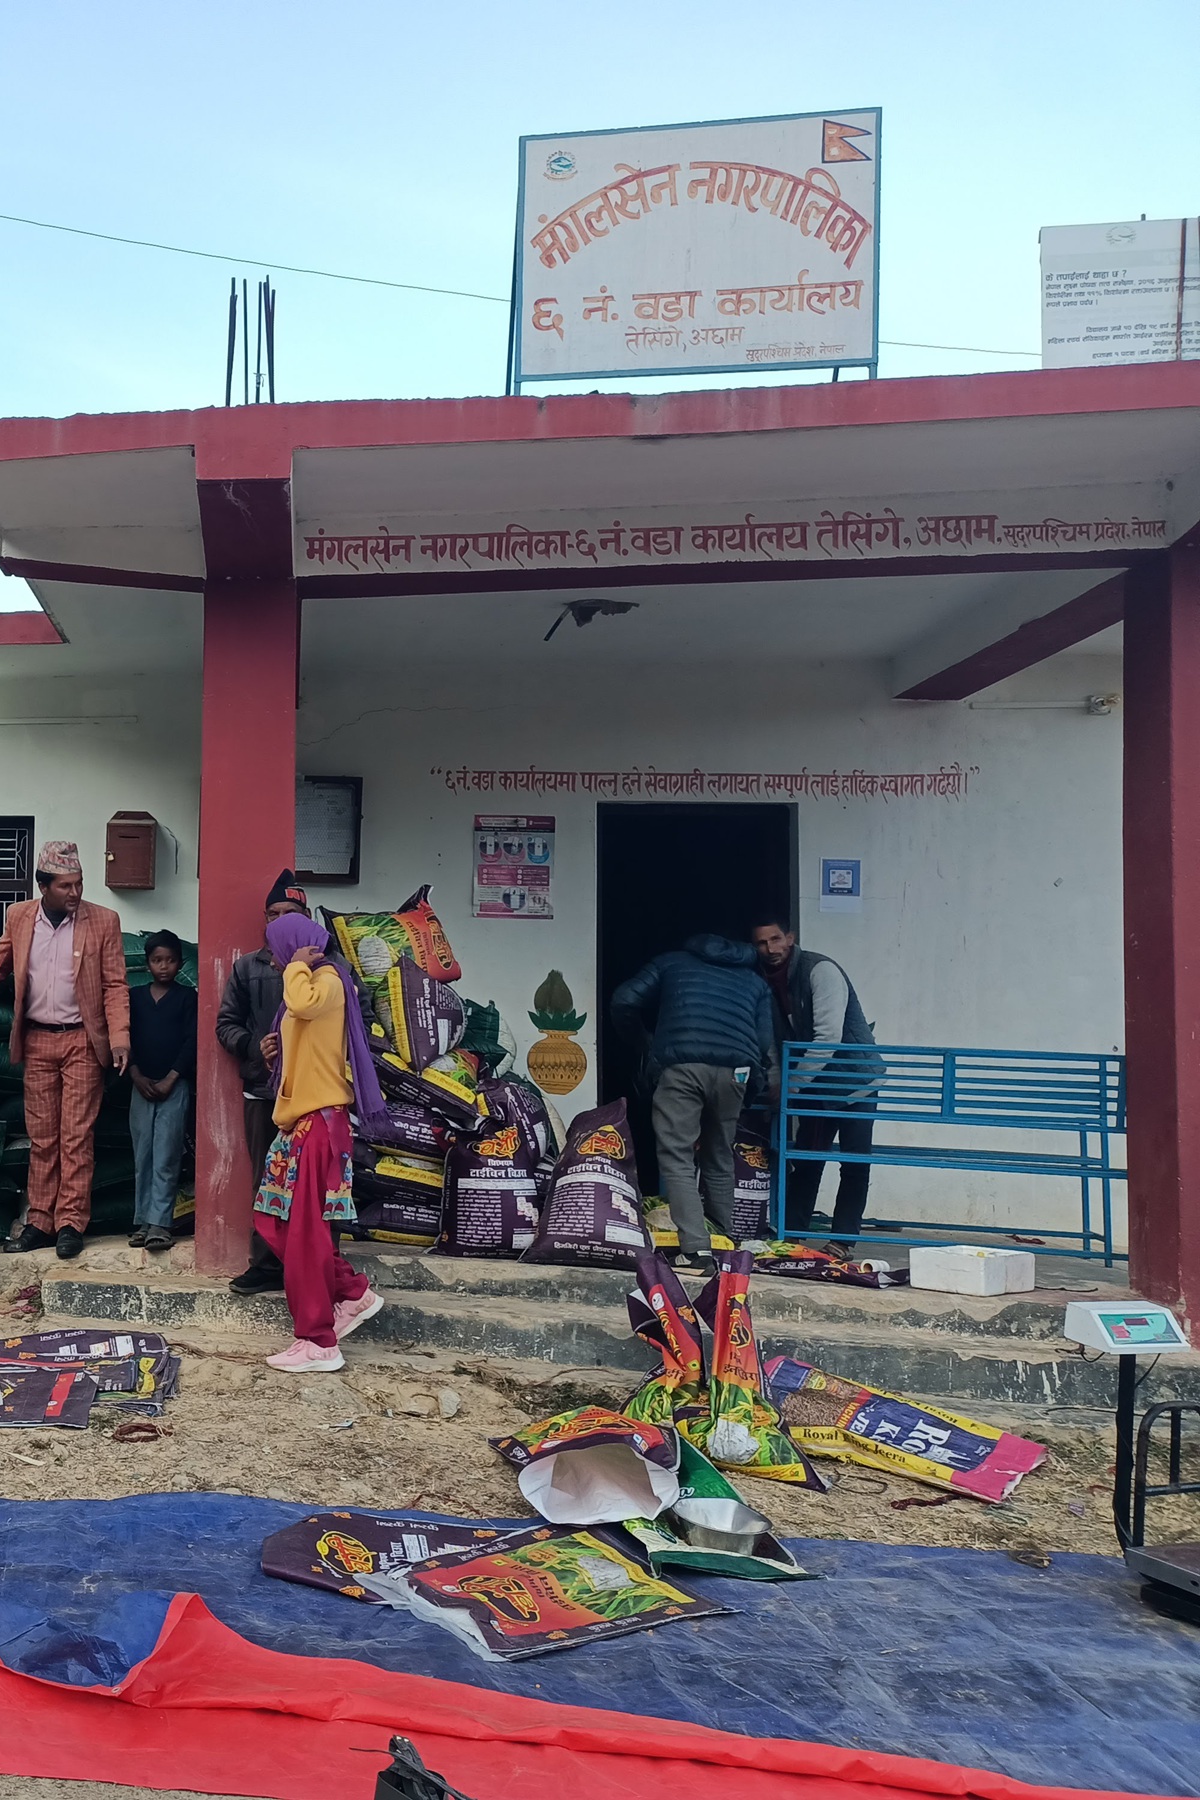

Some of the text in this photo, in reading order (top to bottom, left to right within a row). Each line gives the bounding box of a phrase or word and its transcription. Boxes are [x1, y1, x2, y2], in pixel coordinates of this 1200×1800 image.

[531, 161, 872, 269] मंगलसेन नगरपालिका
[532, 297, 564, 341] ६
[632, 290, 702, 322] वडा
[716, 269, 864, 316] कार्यालय
[688, 326, 745, 344] अछाम
[819, 342, 846, 354] नेपाल
[304, 526, 415, 571] मंगलसेन
[630, 526, 683, 556] वडा
[691, 513, 809, 561] कार्यालय
[1131, 517, 1166, 541] नेपाल
[498, 765, 577, 797] कार्यालयमा
[621, 766, 643, 797] हुने
[644, 765, 705, 797] सेवाग्राही
[707, 772, 762, 798] लगायत
[879, 773, 925, 804] स्वागत
[803, 1428, 838, 1443] Royal
[874, 1442, 906, 1463] Jeera
